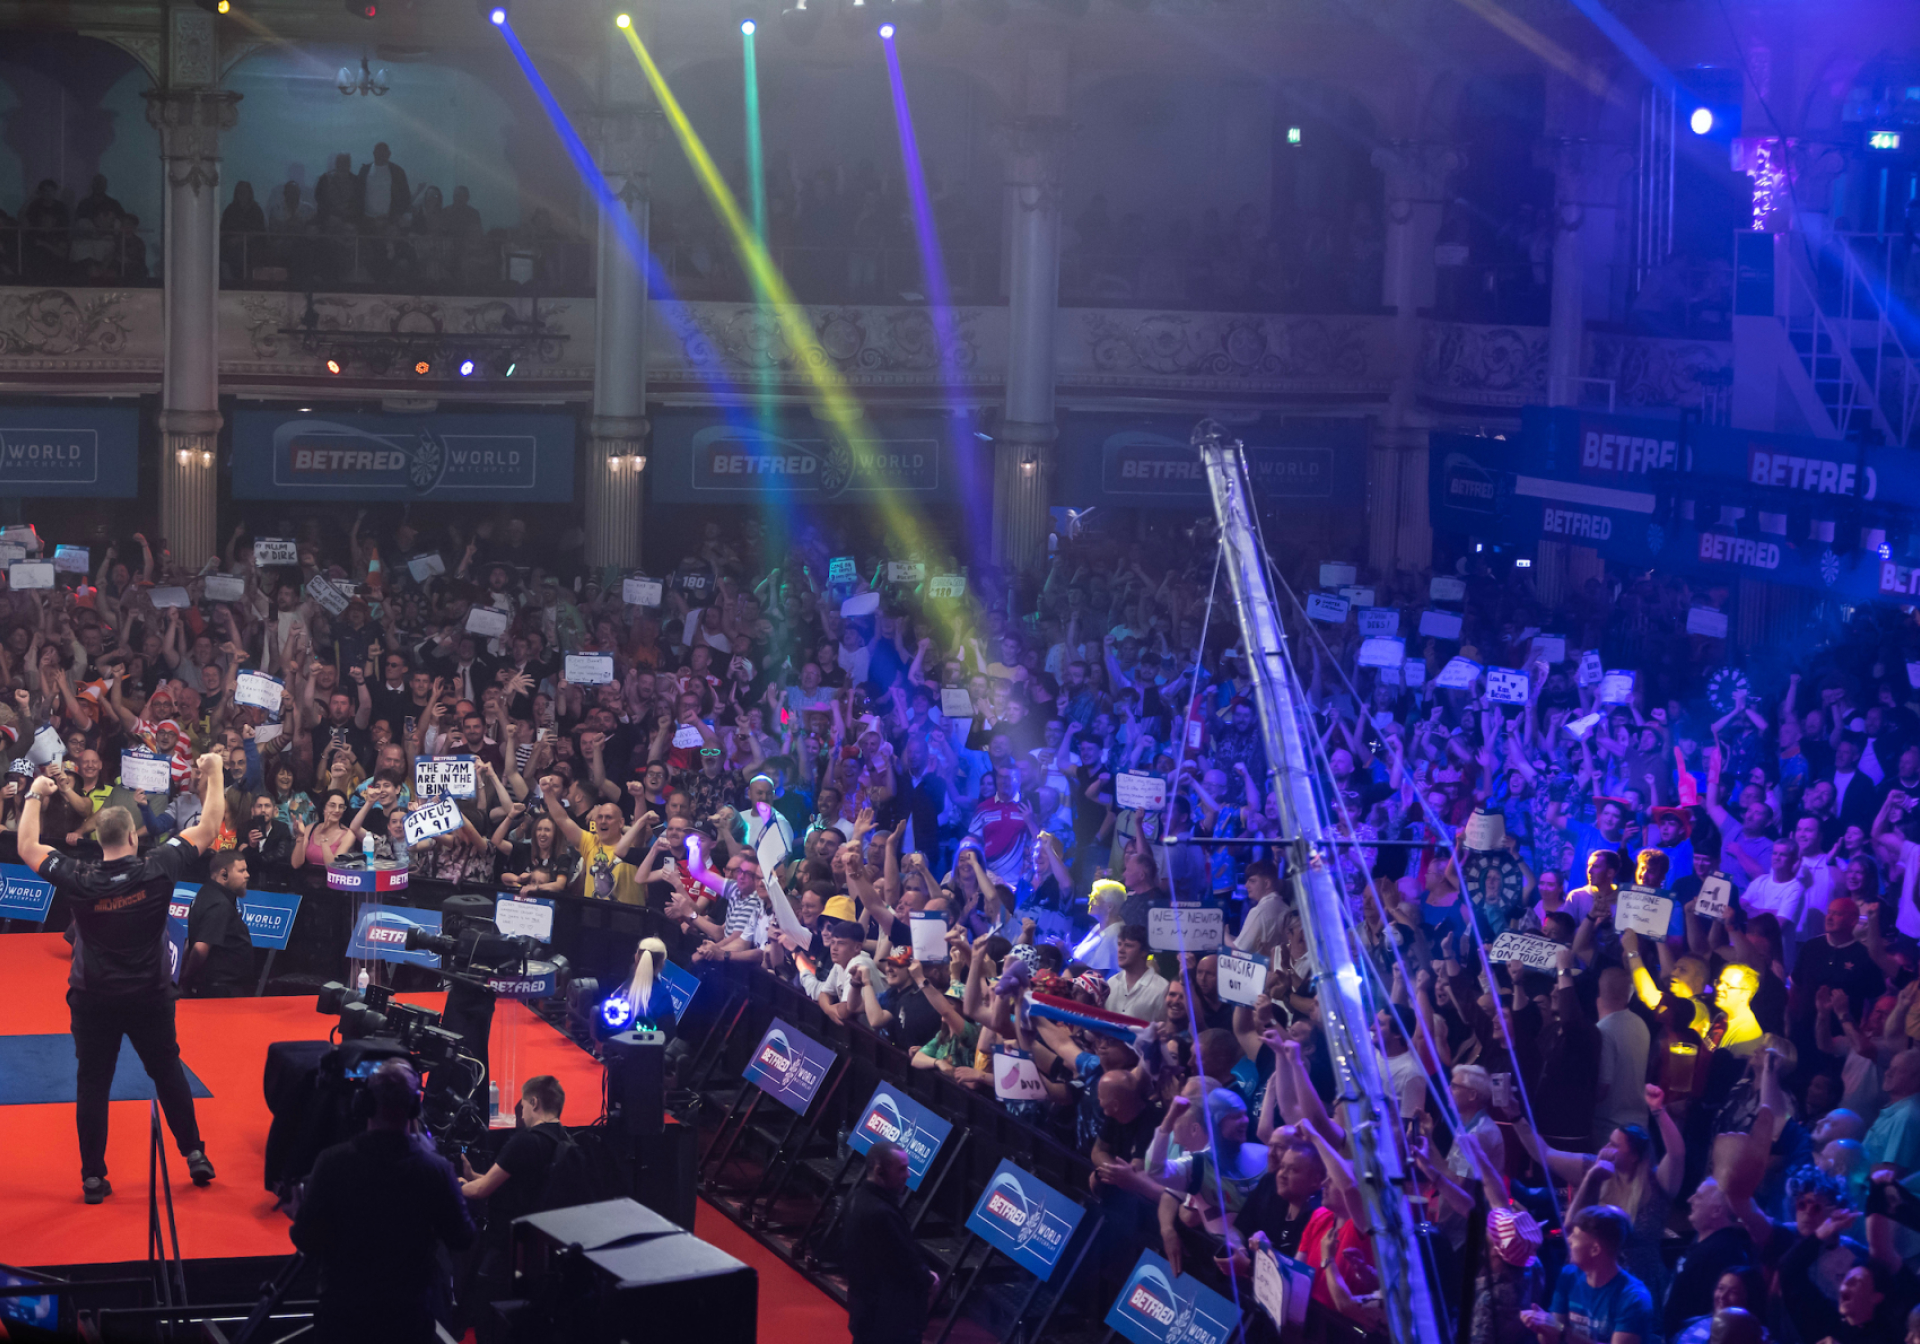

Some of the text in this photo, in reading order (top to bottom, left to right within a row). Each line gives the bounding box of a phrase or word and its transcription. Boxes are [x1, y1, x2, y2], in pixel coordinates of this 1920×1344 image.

[8, 444, 81, 460] WORLD
[451, 450, 520, 465] WORLD
[5, 460, 82, 468] MATCHPLAY
[295, 450, 405, 470] BETFRED
[713, 455, 817, 474] BETFRED
[860, 455, 924, 469] WORLD
[449, 465, 522, 473] MATCHPLAY
[1122, 461, 1204, 480] BETFRE
[1259, 462, 1320, 476] WORLD
[1449, 477, 1494, 500] BETFRED
[1543, 508, 1612, 541] BETFRED
[272, 551, 296, 560] DIRK
[1701, 532, 1781, 570] BETFRED
[683, 576, 706, 589] 180
[1880, 562, 1920, 596] BET
[936, 587, 952, 598] 180
[1314, 598, 1321, 606] 9
[419, 763, 469, 773] THE JAM
[417, 774, 472, 784] ARE IN THE
[408, 807, 437, 828] GIVE
[437, 799, 453, 816] US
[415, 827, 424, 838] A
[5, 894, 40, 902] MATCHPLAY
[8, 885, 42, 898] WORLD
[246, 912, 282, 925] WORLD
[1152, 910, 1185, 923] WEZ
[245, 921, 280, 929] ATCHPLAY
[368, 927, 408, 943] BETF
[1152, 928, 1218, 940] IS MY DAD
[1494, 941, 1544, 956] LADIES
[1499, 934, 1557, 951] LYTHAM
[1496, 950, 1514, 960] ON
[1219, 957, 1256, 979] CHANSIRI
[489, 979, 546, 994] BETFRED
[1229, 979, 1241, 991] OUT
[761, 1047, 791, 1073] BETFRED
[798, 1067, 817, 1085] WORLD
[1020, 1079, 1041, 1090] DVD
[866, 1113, 901, 1143] BETFRED
[909, 1139, 931, 1159] WORLD
[988, 1194, 1027, 1227] BETFRED
[1038, 1223, 1062, 1246] WORLD
[1130, 1288, 1176, 1326] BETFRED
[1188, 1323, 1217, 1344] WORLD
